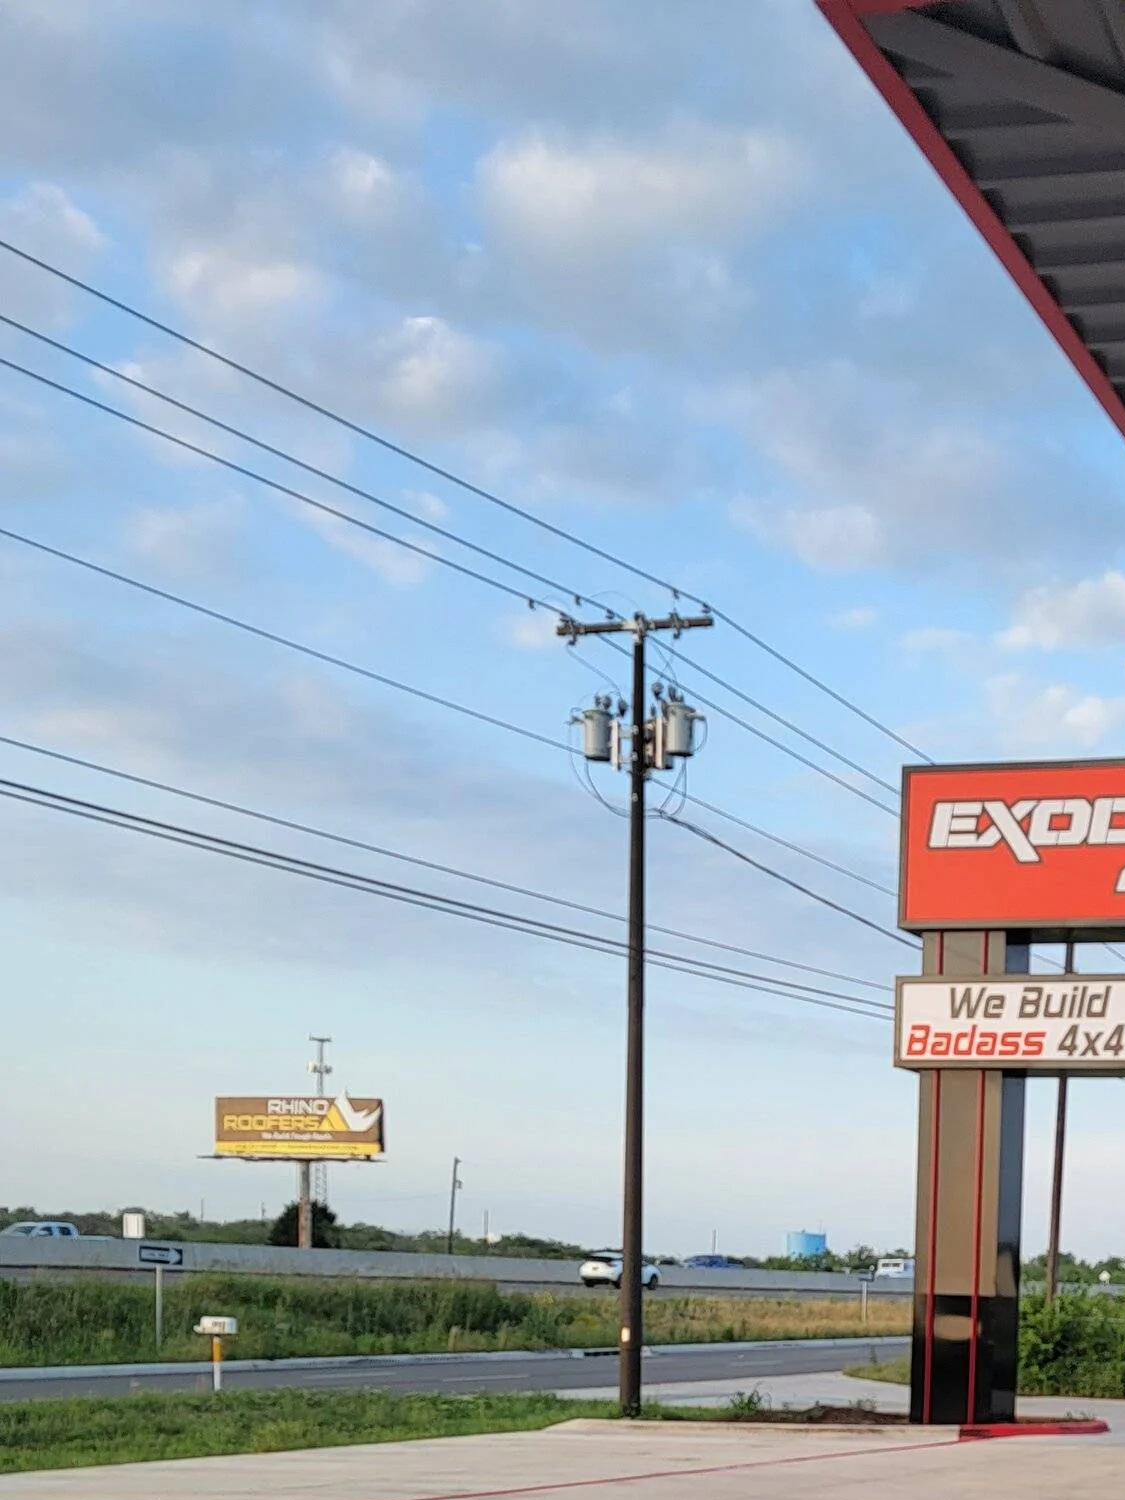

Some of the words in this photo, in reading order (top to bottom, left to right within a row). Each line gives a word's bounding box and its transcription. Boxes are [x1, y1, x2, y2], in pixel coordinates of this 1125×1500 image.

[950, 986, 1007, 1019] We
[1018, 985, 1112, 1019] Build
[906, 1024, 1047, 1056] Badass
[267, 1099, 330, 1115] RHINO
[223, 1114, 320, 1131] ROOFERS
